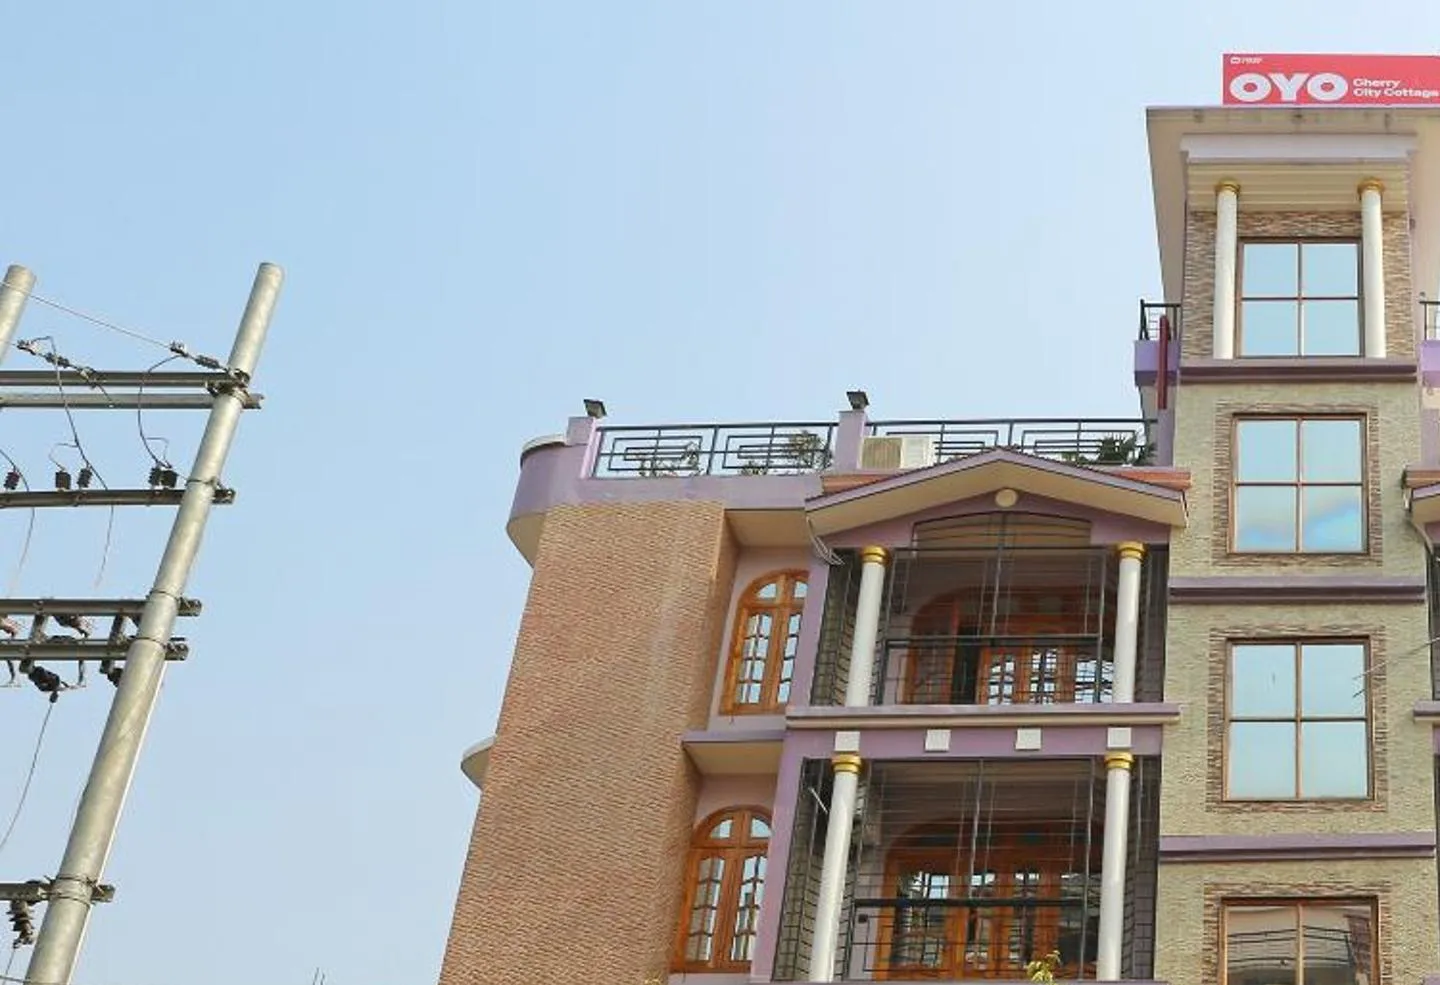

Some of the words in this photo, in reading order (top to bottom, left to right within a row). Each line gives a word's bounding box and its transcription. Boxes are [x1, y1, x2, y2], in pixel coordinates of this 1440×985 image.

[1229, 72, 1348, 102] OYO
[1353, 78, 1400, 88] Cherry
[1353, 88, 1381, 98] City
[1384, 88, 1440, 98] Cottage
